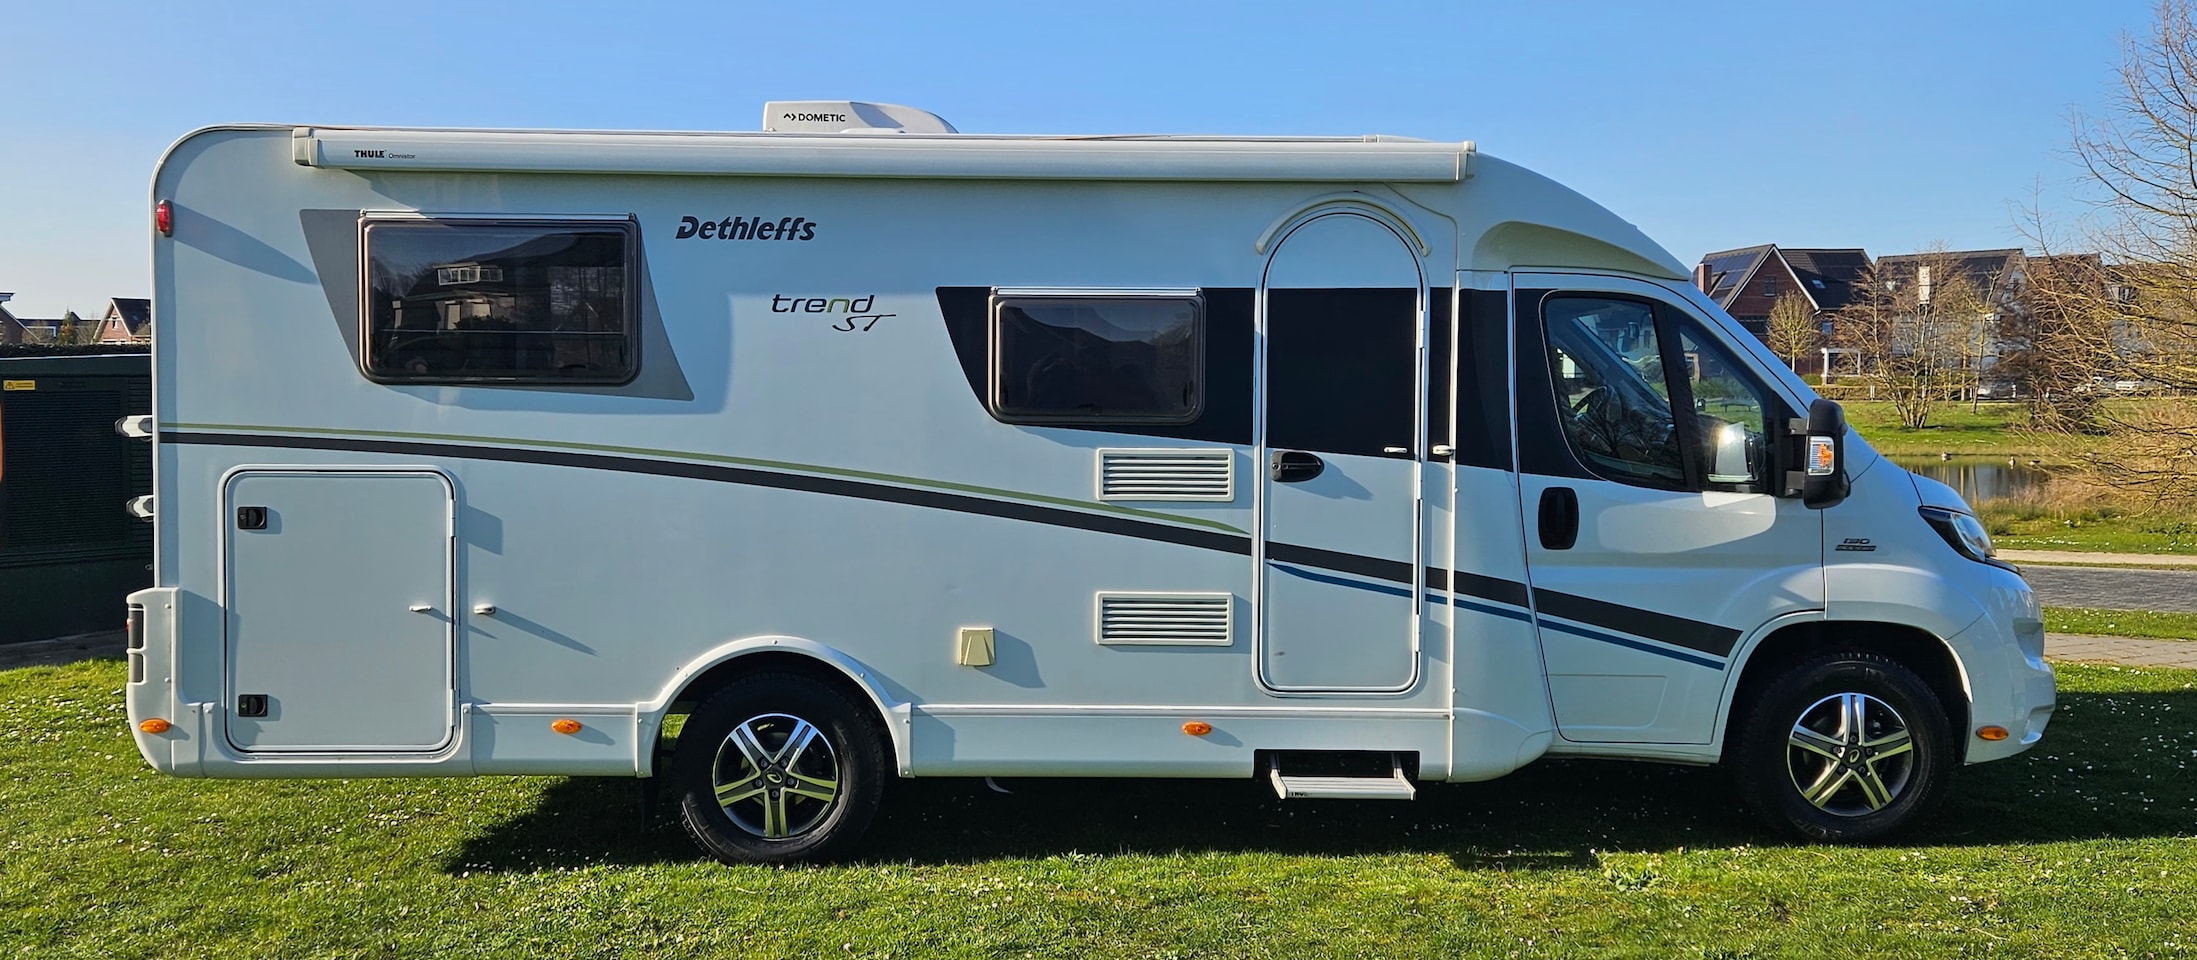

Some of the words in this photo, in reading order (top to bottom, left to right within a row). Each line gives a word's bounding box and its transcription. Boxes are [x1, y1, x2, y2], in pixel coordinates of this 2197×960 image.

[798, 113, 846, 122] DOMETIC
[354, 150, 385, 158] THULE
[675, 216, 817, 241] Dethleffs
[771, 294, 875, 313] trend
